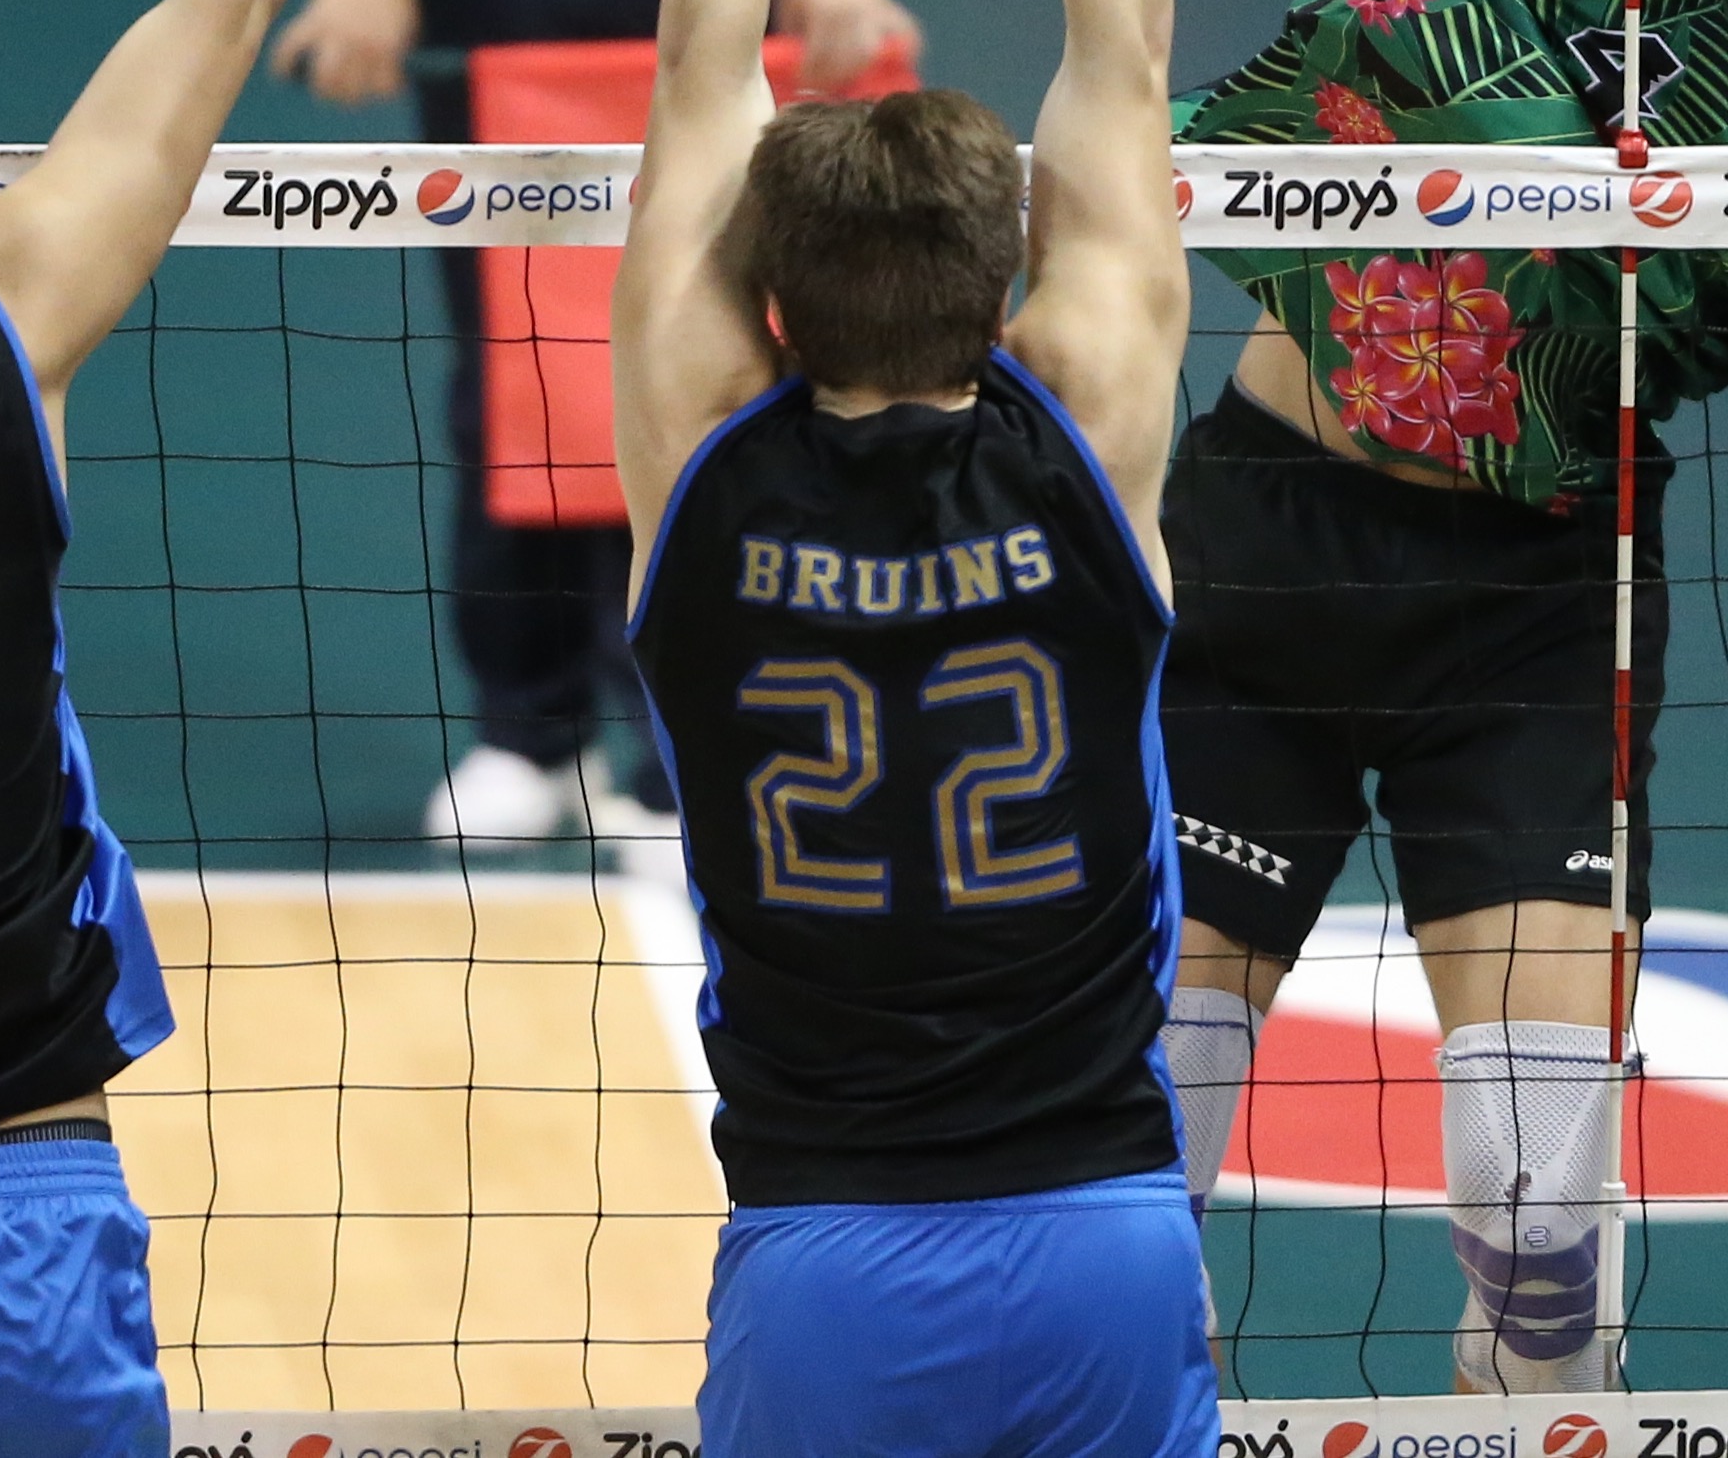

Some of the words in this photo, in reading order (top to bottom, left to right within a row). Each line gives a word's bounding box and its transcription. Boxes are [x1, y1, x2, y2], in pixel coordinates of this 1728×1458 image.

[223, 165, 398, 230] Zippy's
[487, 176, 612, 220] pepsi
[1223, 165, 1397, 231] Zippy's
[1486, 177, 1611, 220] pepsi
[738, 524, 1058, 616] BRUINS
[737, 637, 1085, 915] 22
